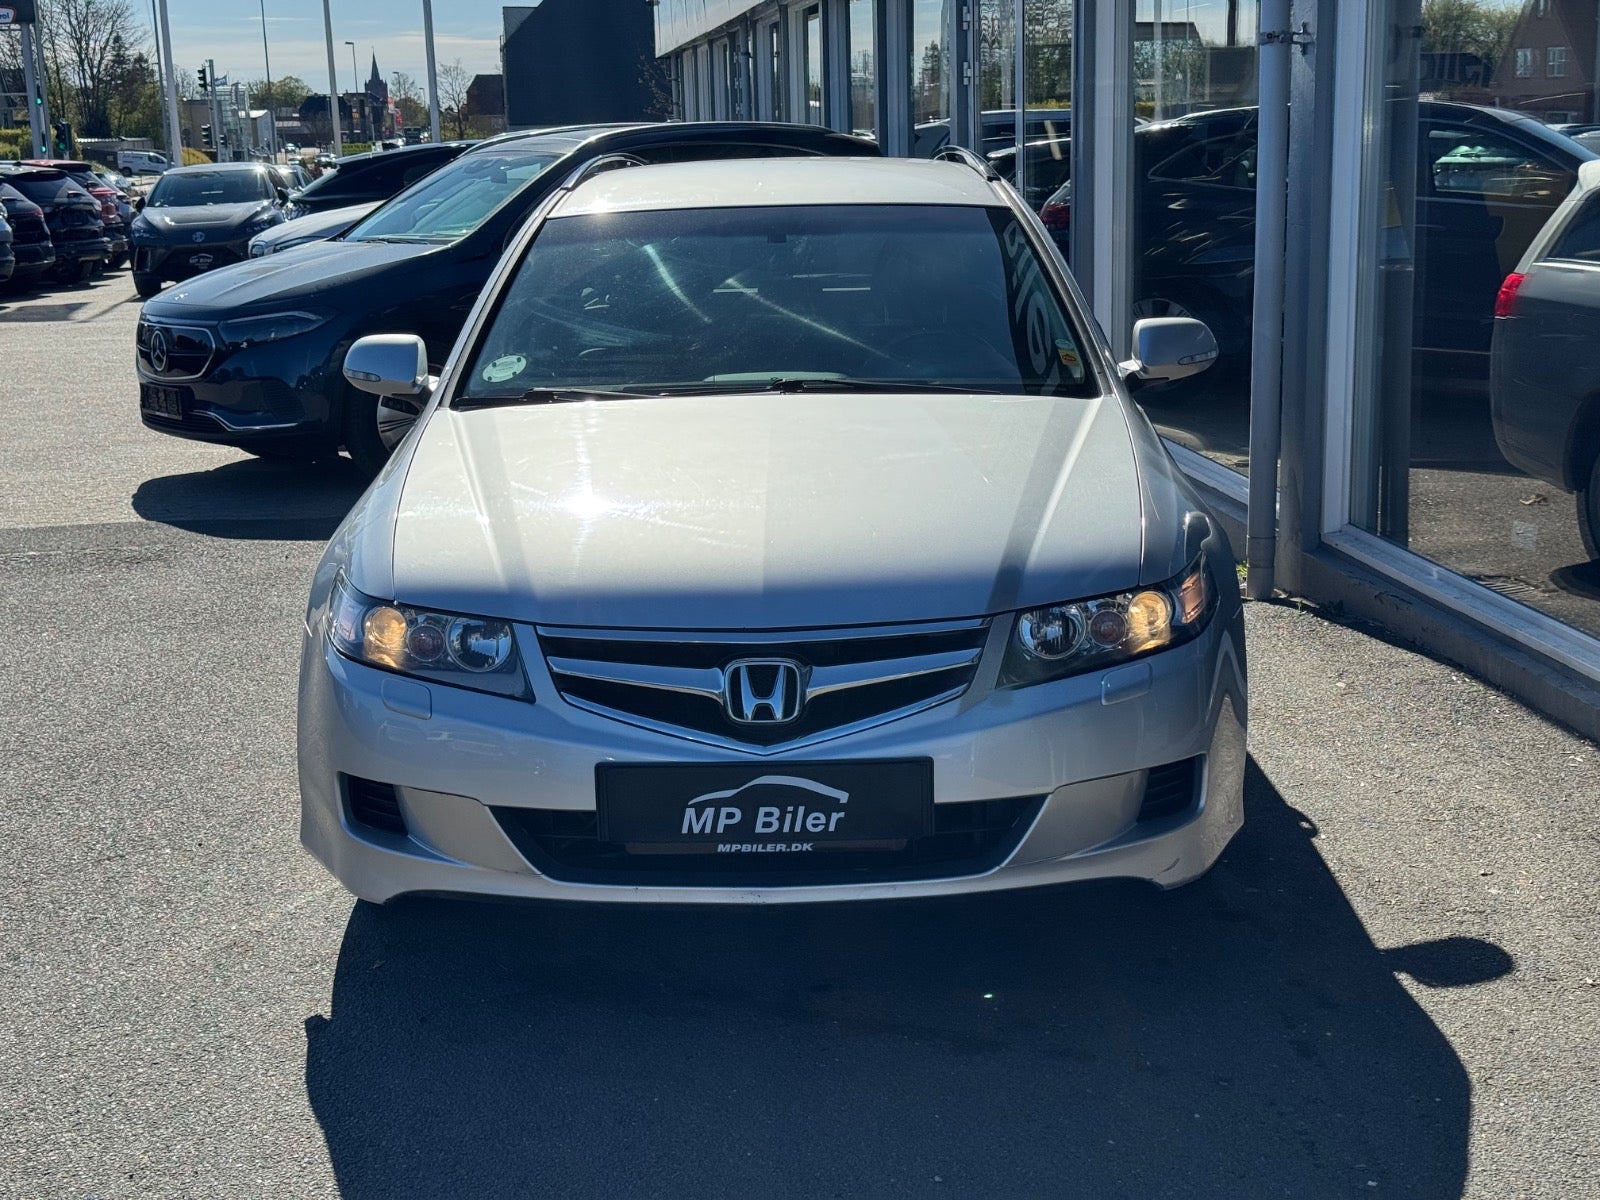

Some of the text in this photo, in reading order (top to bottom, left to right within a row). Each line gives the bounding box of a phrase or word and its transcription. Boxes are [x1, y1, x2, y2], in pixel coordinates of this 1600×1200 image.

[681, 805, 846, 834] MP Biler
[716, 842, 814, 853] MPBILER.DK
